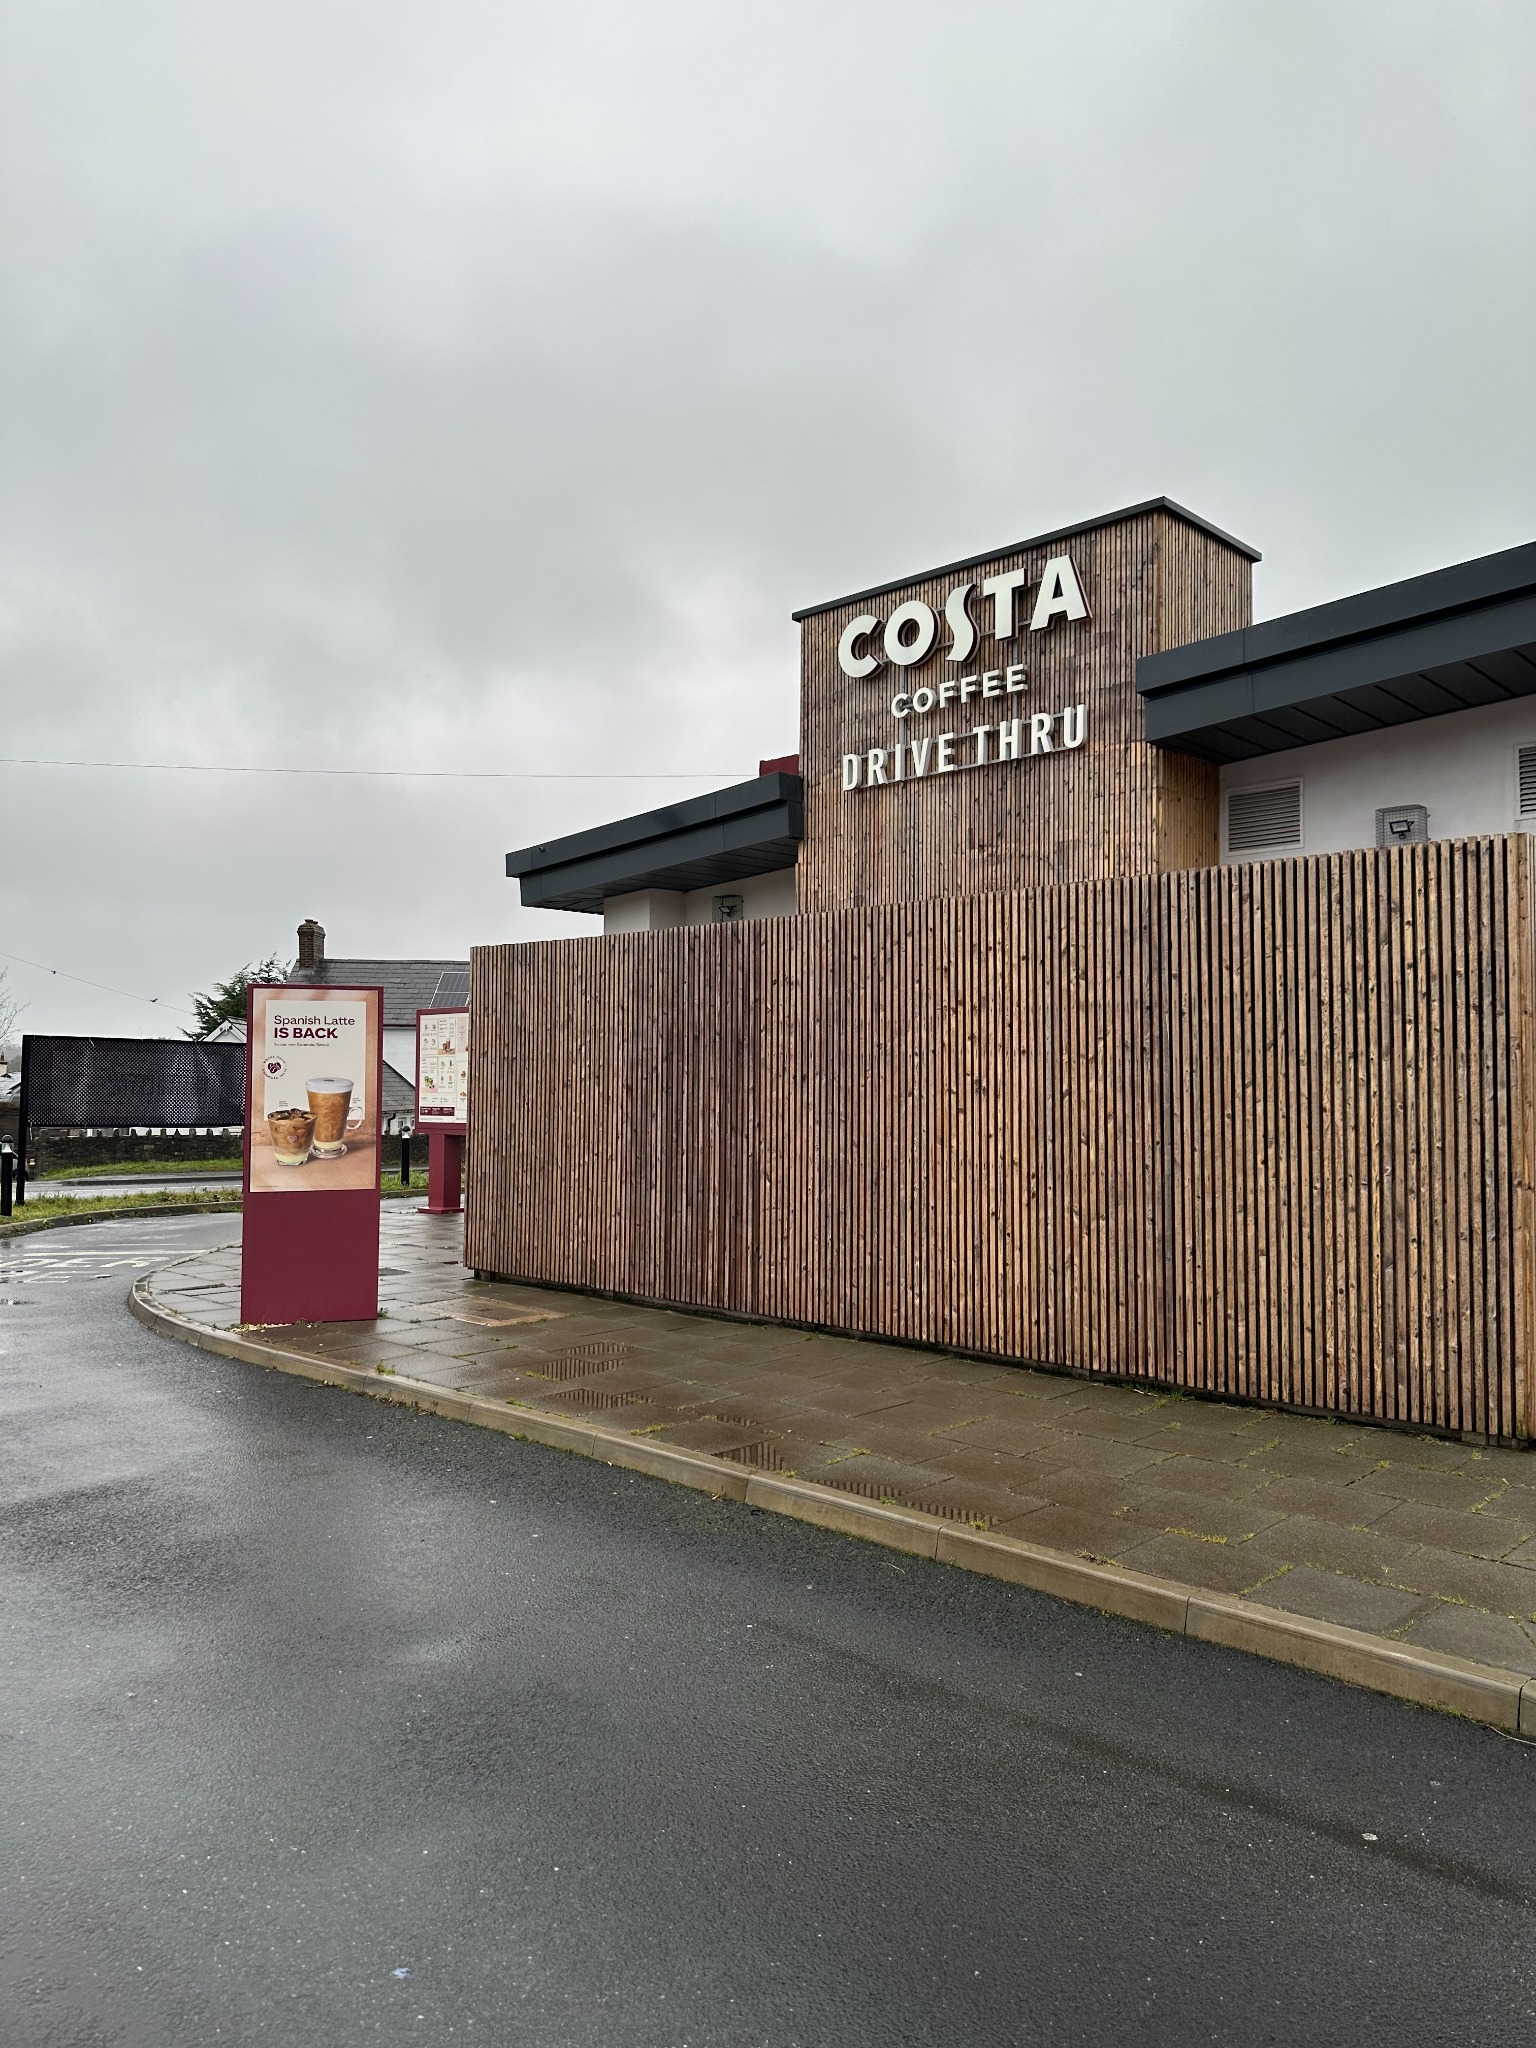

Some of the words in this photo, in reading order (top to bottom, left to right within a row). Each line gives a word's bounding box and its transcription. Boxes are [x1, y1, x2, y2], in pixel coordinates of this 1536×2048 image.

[838, 555, 1092, 679] COSTA
[891, 663, 1028, 718] COFFEE
[842, 732, 958, 791] DRIVE
[972, 704, 1088, 767] THRU
[273, 1014, 321, 1026] Spanish
[324, 1015, 356, 1026] Latte
[273, 1027, 289, 1039] IS
[293, 1027, 338, 1039] BACK
